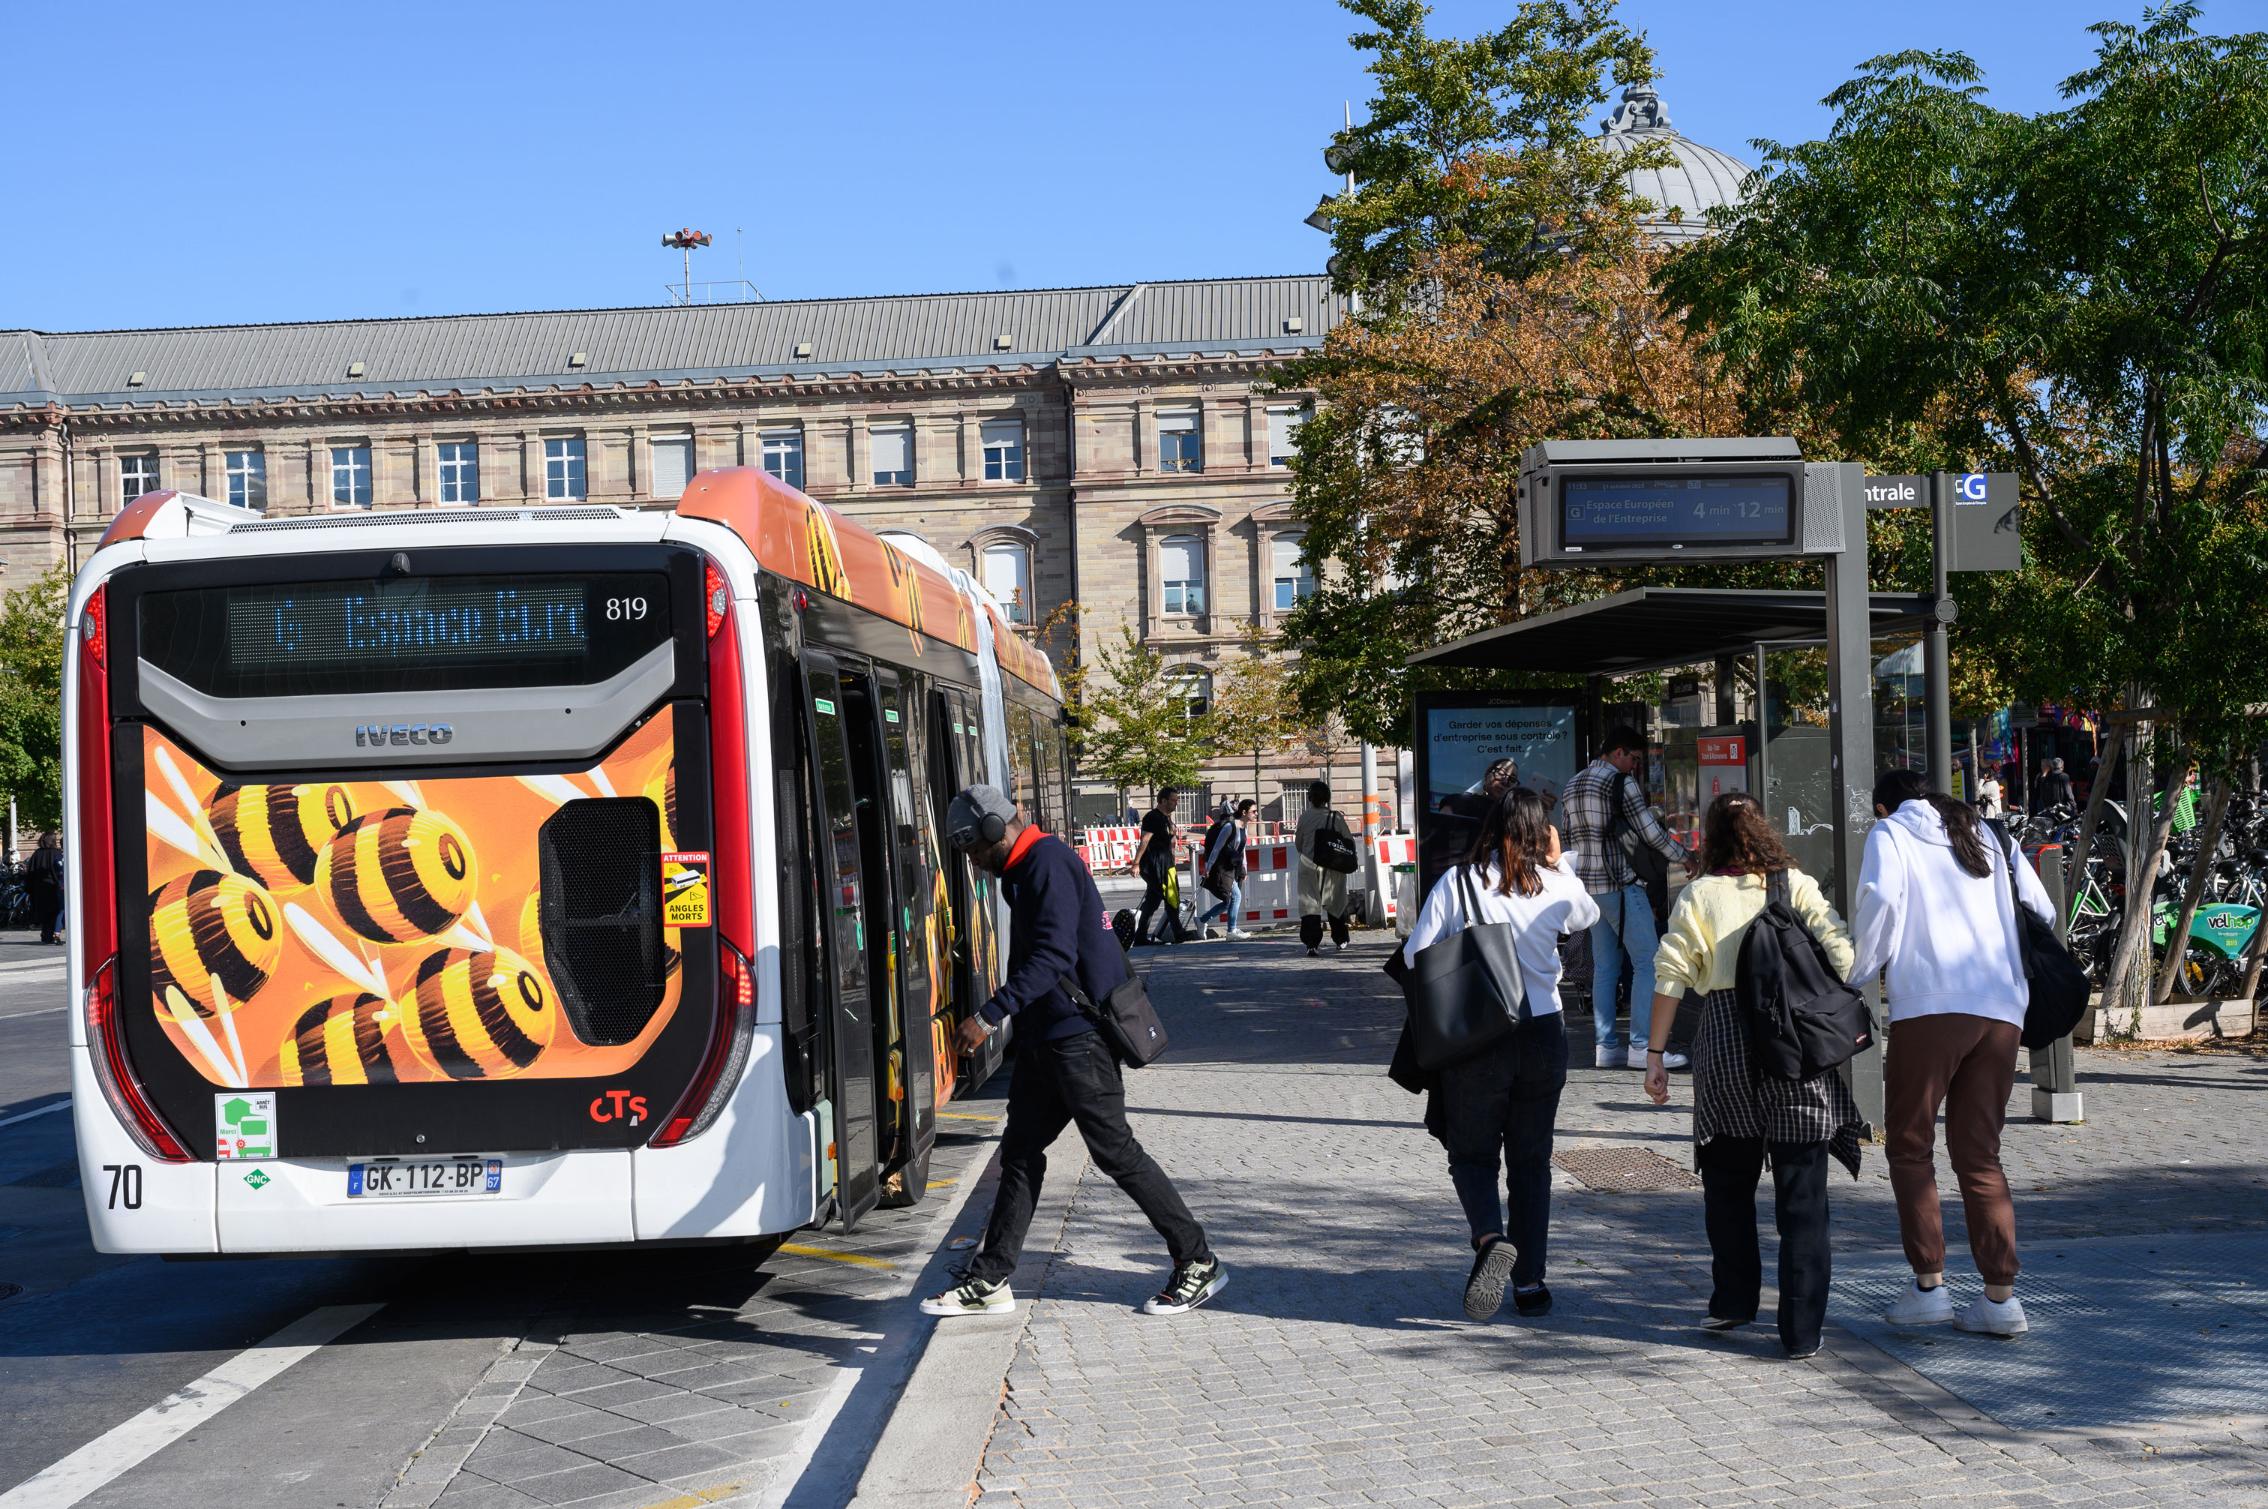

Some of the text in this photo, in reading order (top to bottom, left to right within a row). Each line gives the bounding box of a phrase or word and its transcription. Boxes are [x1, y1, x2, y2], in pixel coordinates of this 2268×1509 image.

[1963, 473, 1986, 500] G
[1586, 498, 1674, 513] Espace Européen
[1692, 501, 1785, 519] 4 min 12 min
[1570, 507, 1581, 518] G
[1593, 512, 1668, 526] de l'Entreprise
[606, 597, 648, 621] 819
[345, 596, 483, 658] Espace
[1448, 719, 1553, 730] Garder vos dépenses
[356, 723, 454, 748] IVECO
[1433, 733, 1493, 744] d'entreprise
[1494, 734, 1519, 742] sous
[1520, 731, 1561, 742] contrôle
[1476, 744, 1526, 754] C'est fait.
[664, 854, 707, 862] ATTENTION
[669, 904, 704, 913] ANGLES
[671, 912, 703, 921] MORTS
[220, 1128, 237, 1136] Merci
[246, 1174, 267, 1185] GNC
[353, 1182, 358, 1190] F
[487, 1176, 499, 1188] 67
[102, 1164, 143, 1210] 70
